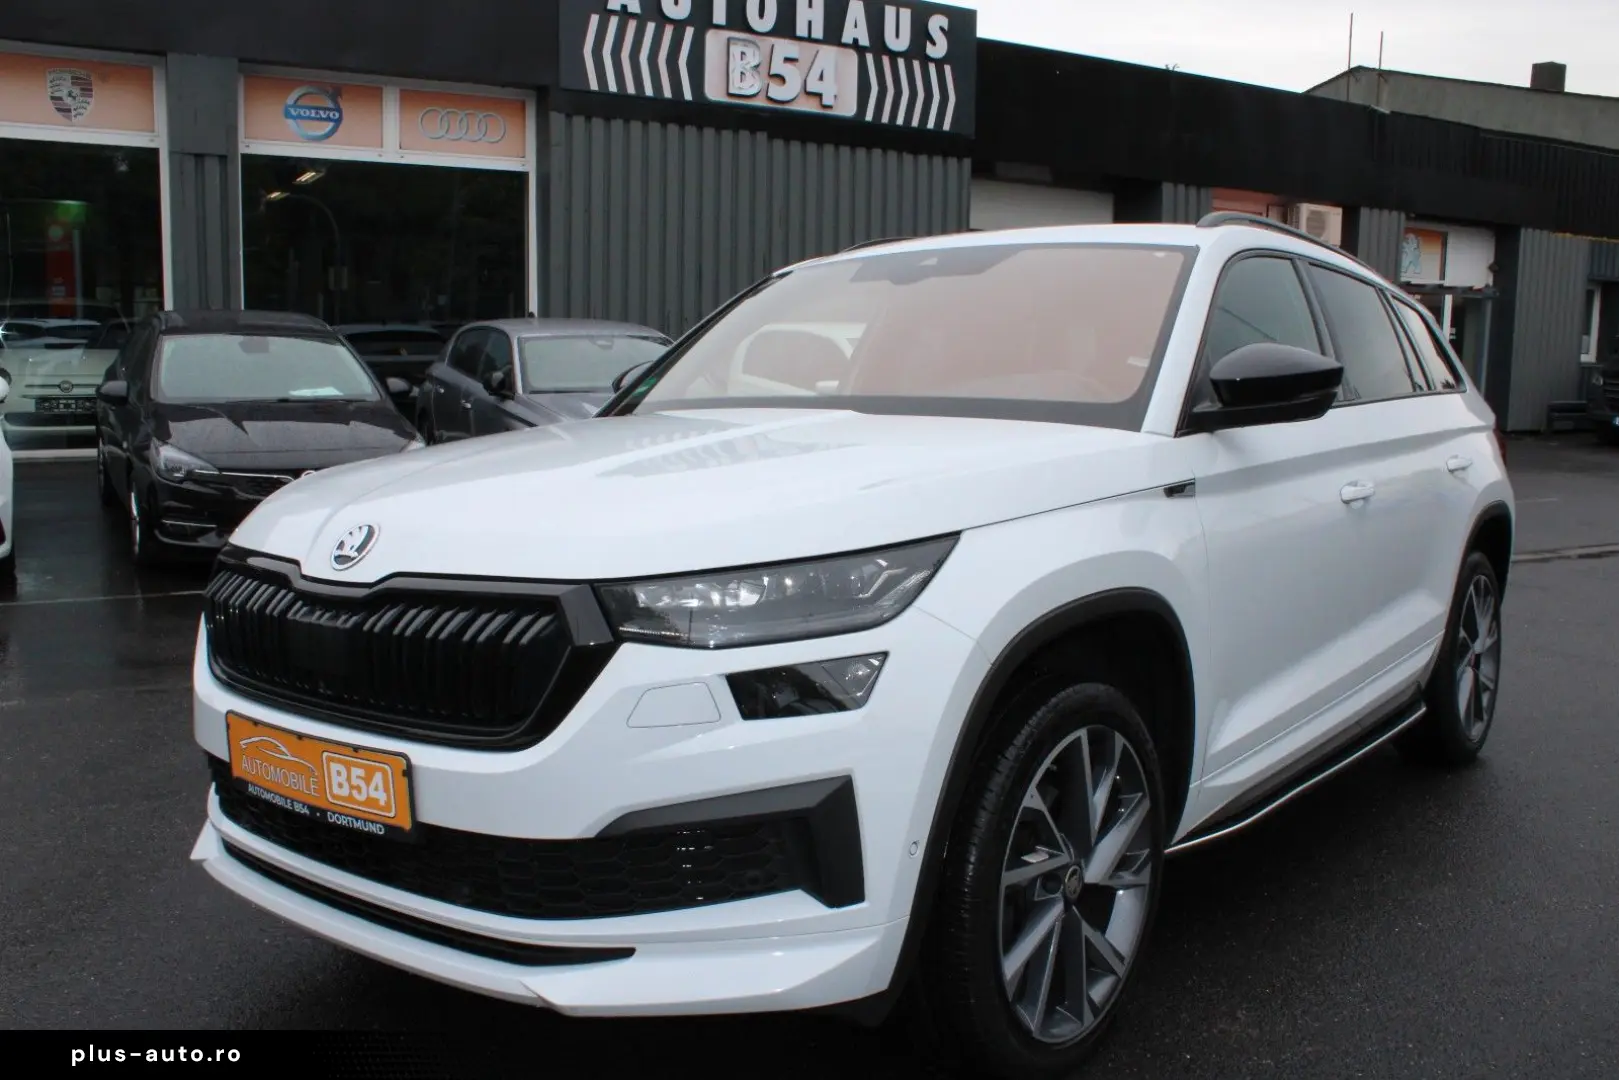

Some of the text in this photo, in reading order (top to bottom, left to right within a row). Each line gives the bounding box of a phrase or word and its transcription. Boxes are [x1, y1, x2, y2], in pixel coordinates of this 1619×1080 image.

[727, 36, 838, 108] B54
[287, 107, 340, 119] VOLVO
[242, 757, 320, 797] AUTOMOBILE
[329, 761, 387, 806] B54
[248, 783, 293, 810] AUTOMOBILE
[327, 811, 385, 835] DORTMUND
